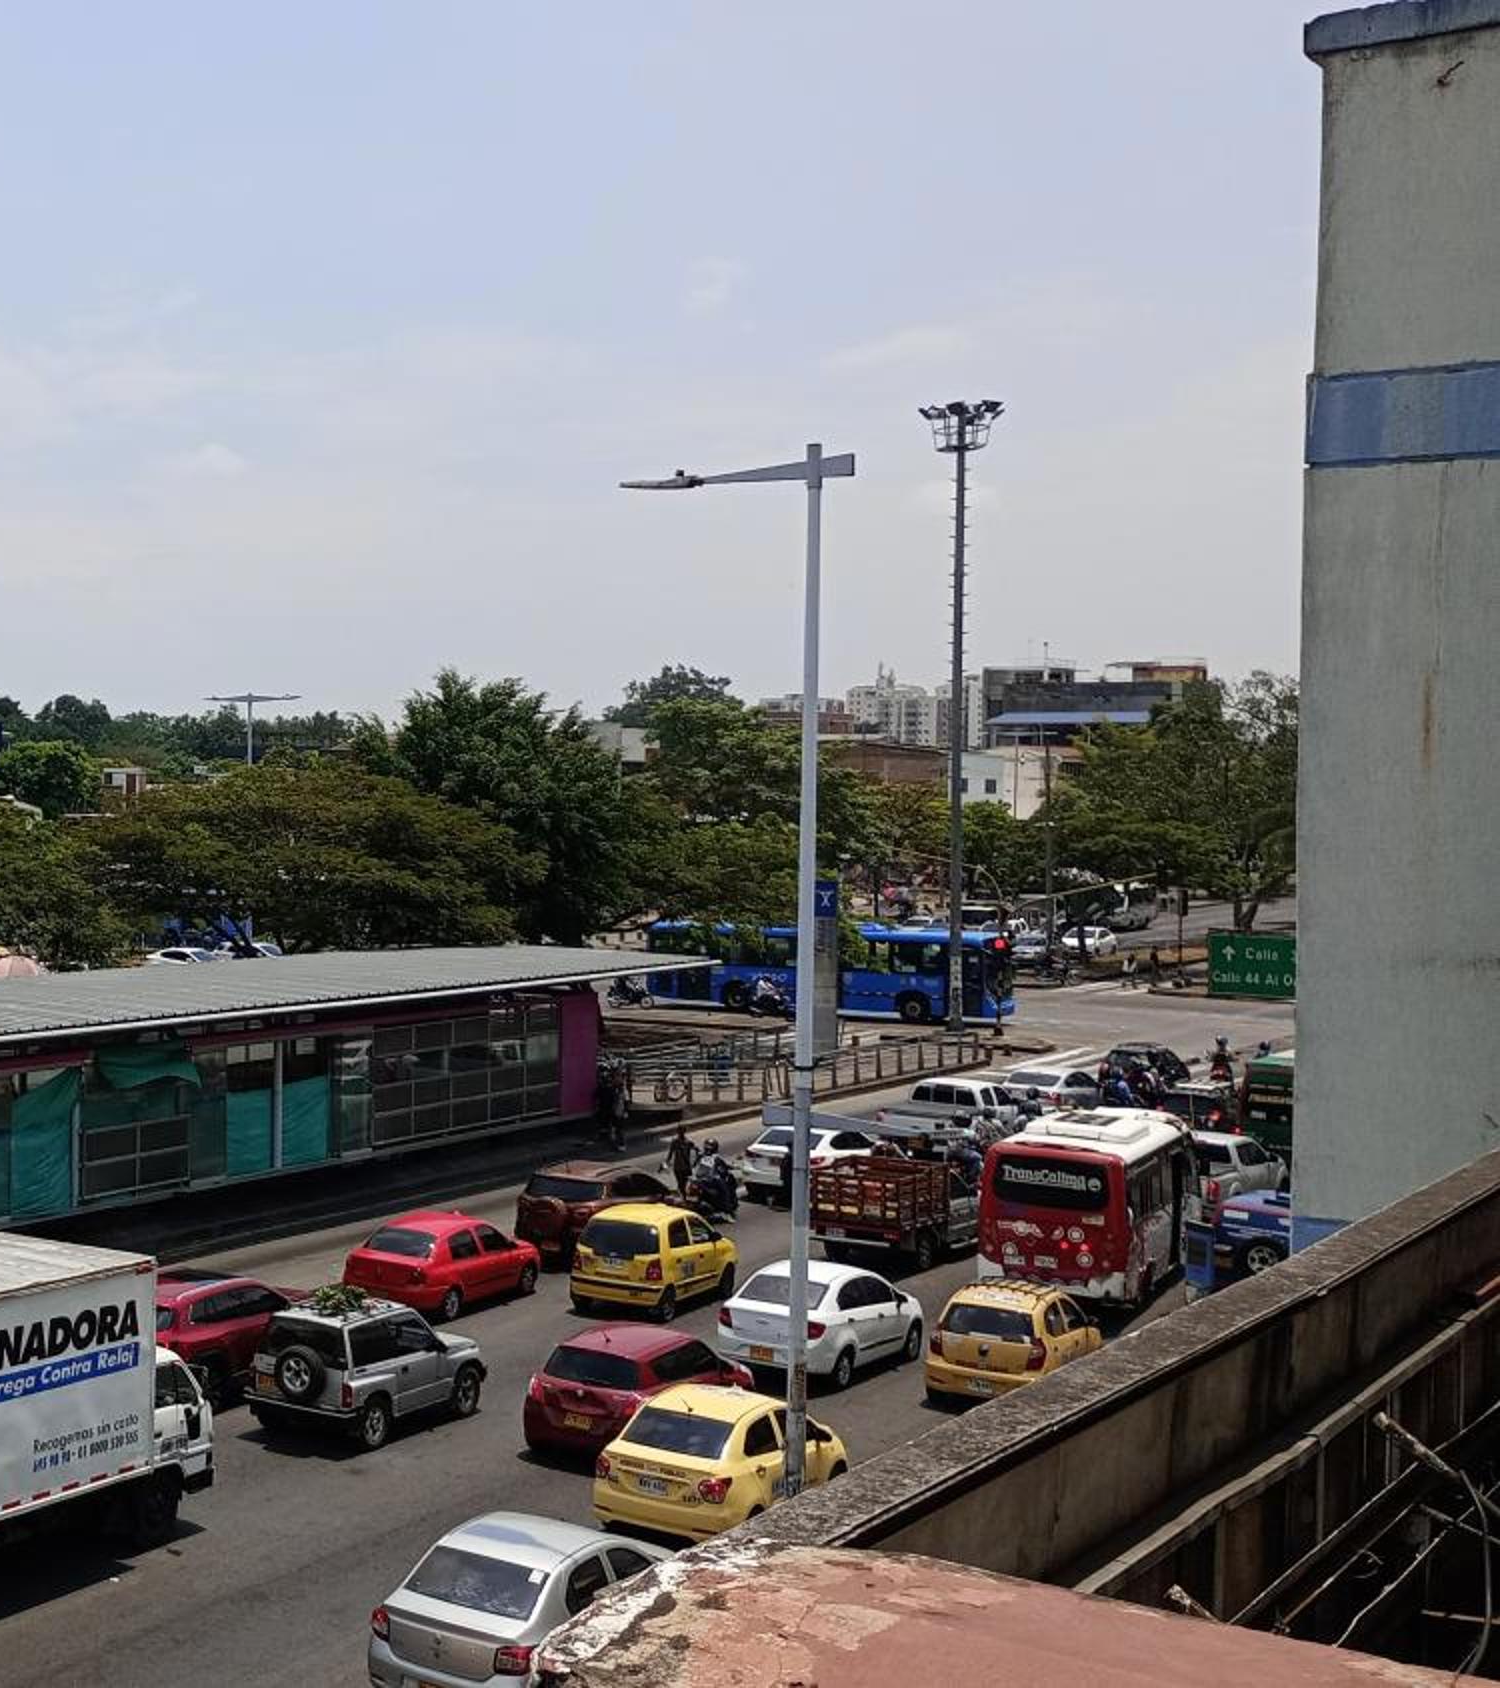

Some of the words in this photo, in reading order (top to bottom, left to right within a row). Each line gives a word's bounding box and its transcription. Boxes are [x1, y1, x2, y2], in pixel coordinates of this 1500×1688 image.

[1245, 947, 1279, 961] Calle
[1212, 970, 1241, 983] Calle
[1245, 972, 1260, 985] 44
[41, 1358, 92, 1385] Contra
[97, 1343, 136, 1369] Reloj
[97, 1419, 111, 1436] sin
